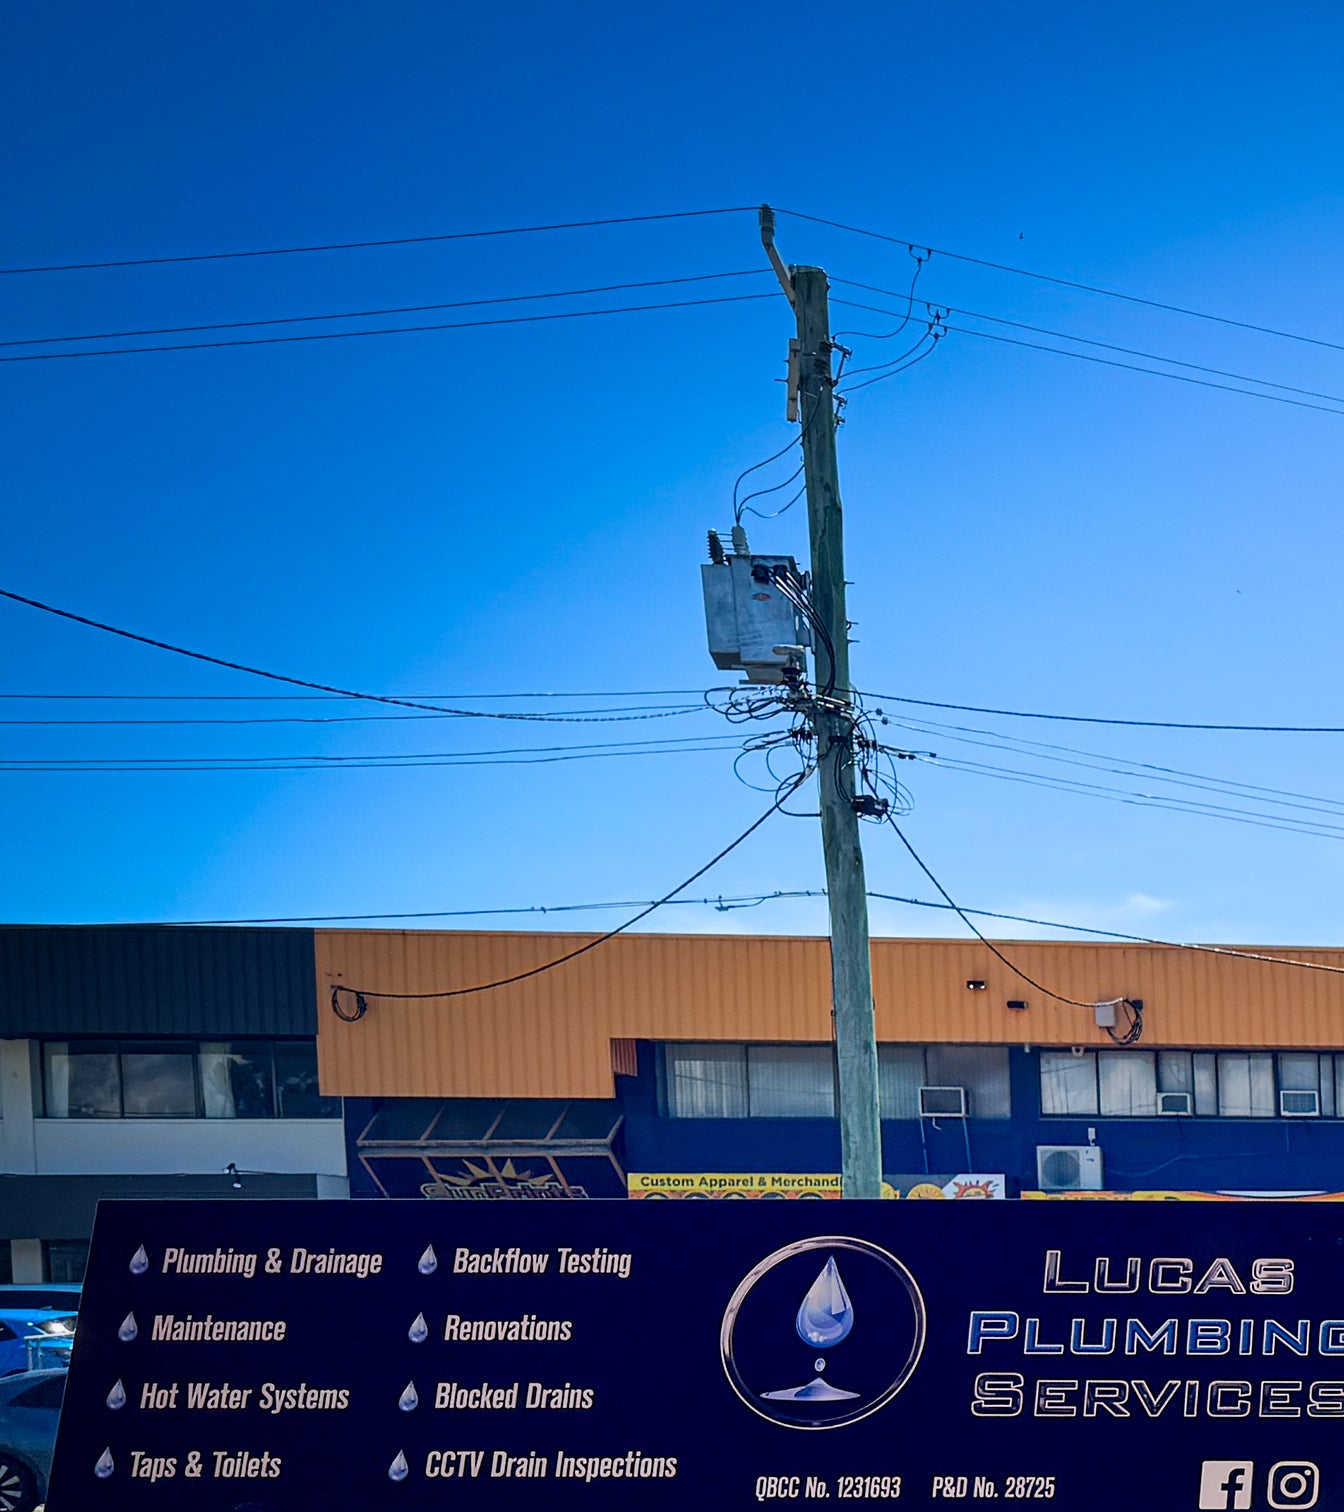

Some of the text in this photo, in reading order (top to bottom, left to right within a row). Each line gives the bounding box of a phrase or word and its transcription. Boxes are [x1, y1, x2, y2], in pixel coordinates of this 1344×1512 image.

[640, 1176, 694, 1187] Custom
[699, 1176, 754, 1190] Apparel
[758, 1176, 767, 1187] &
[163, 1247, 383, 1279] Plumbing & Drainage
[453, 1247, 632, 1279] Backflow Testing
[151, 1314, 287, 1342] Maintenance
[444, 1314, 573, 1342] Renovations
[140, 1382, 350, 1414] Hot Water Systems
[434, 1382, 594, 1410] Blocked Drains
[130, 1451, 282, 1482] Taps & Toilets
[425, 1450, 678, 1482] CCTV Drain Inspections
[755, 1476, 902, 1502] QBCC No. 1231693
[932, 1476, 1056, 1498] P&D No. 28725
